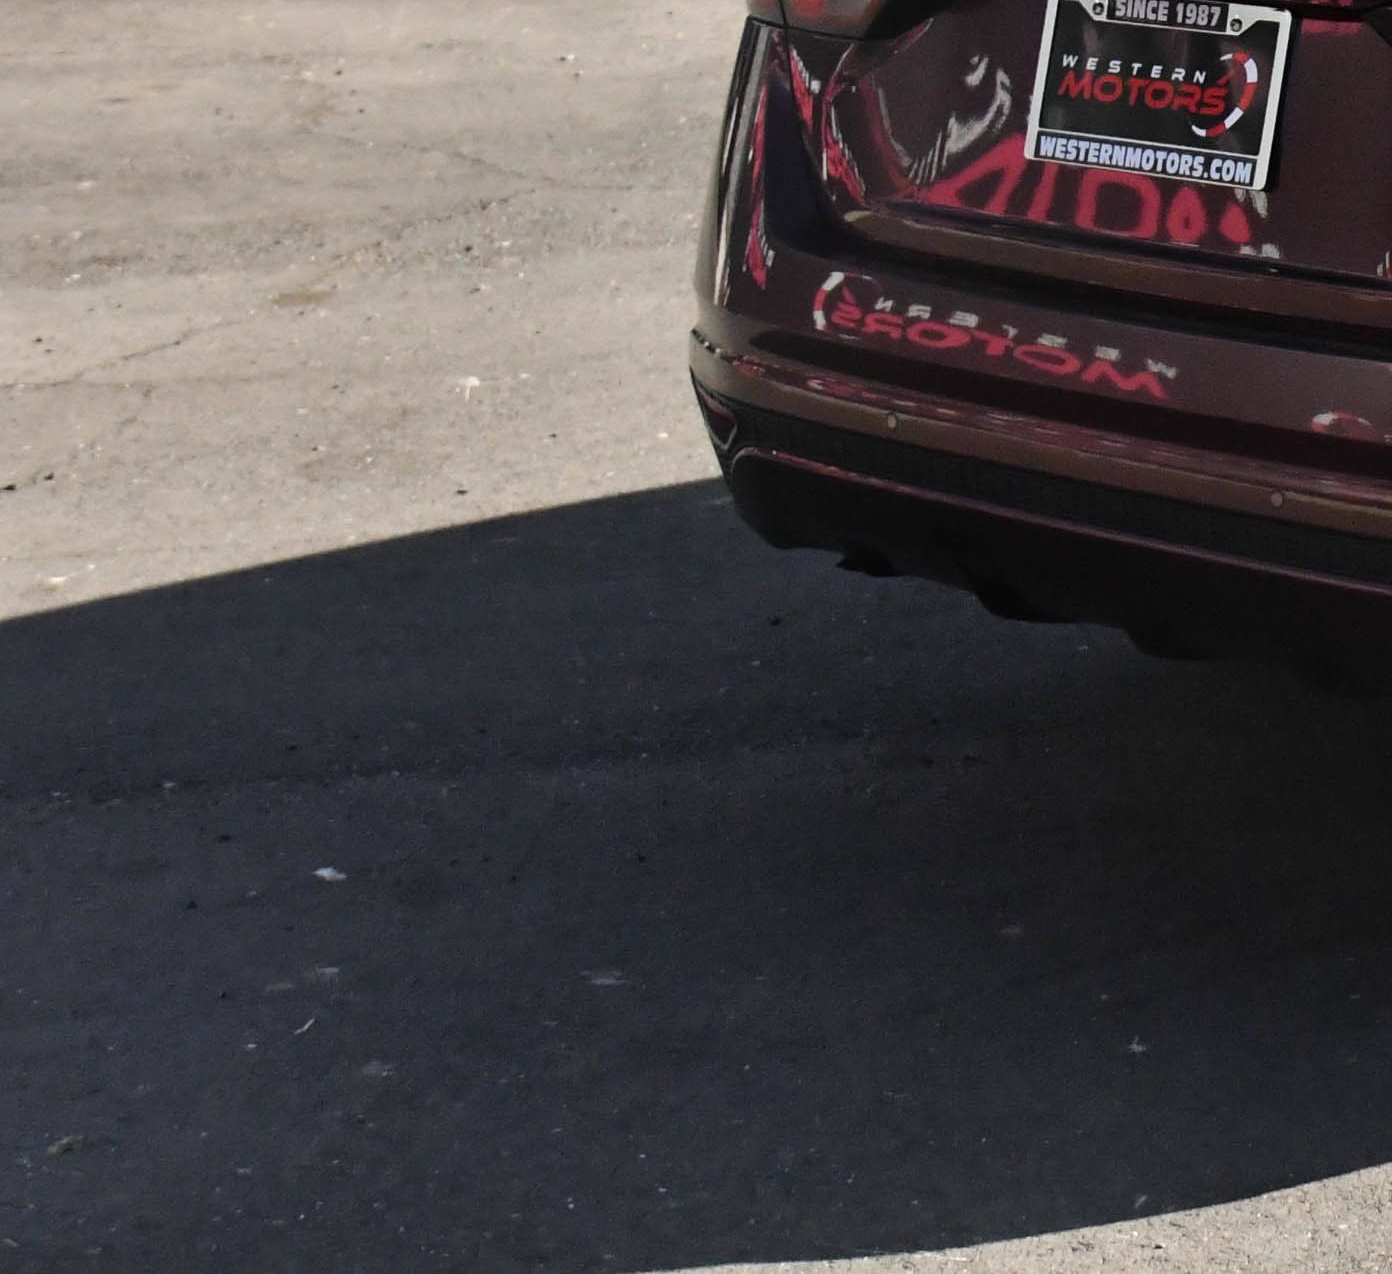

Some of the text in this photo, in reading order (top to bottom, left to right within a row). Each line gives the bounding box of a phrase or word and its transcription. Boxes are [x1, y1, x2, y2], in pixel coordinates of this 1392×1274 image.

[1175, 2, 1222, 27] 1987
[1061, 53, 1207, 85] WESTERN
[1056, 69, 1230, 116] MOTORS
[1039, 134, 1253, 184] WESTERNMOTORS.COM
